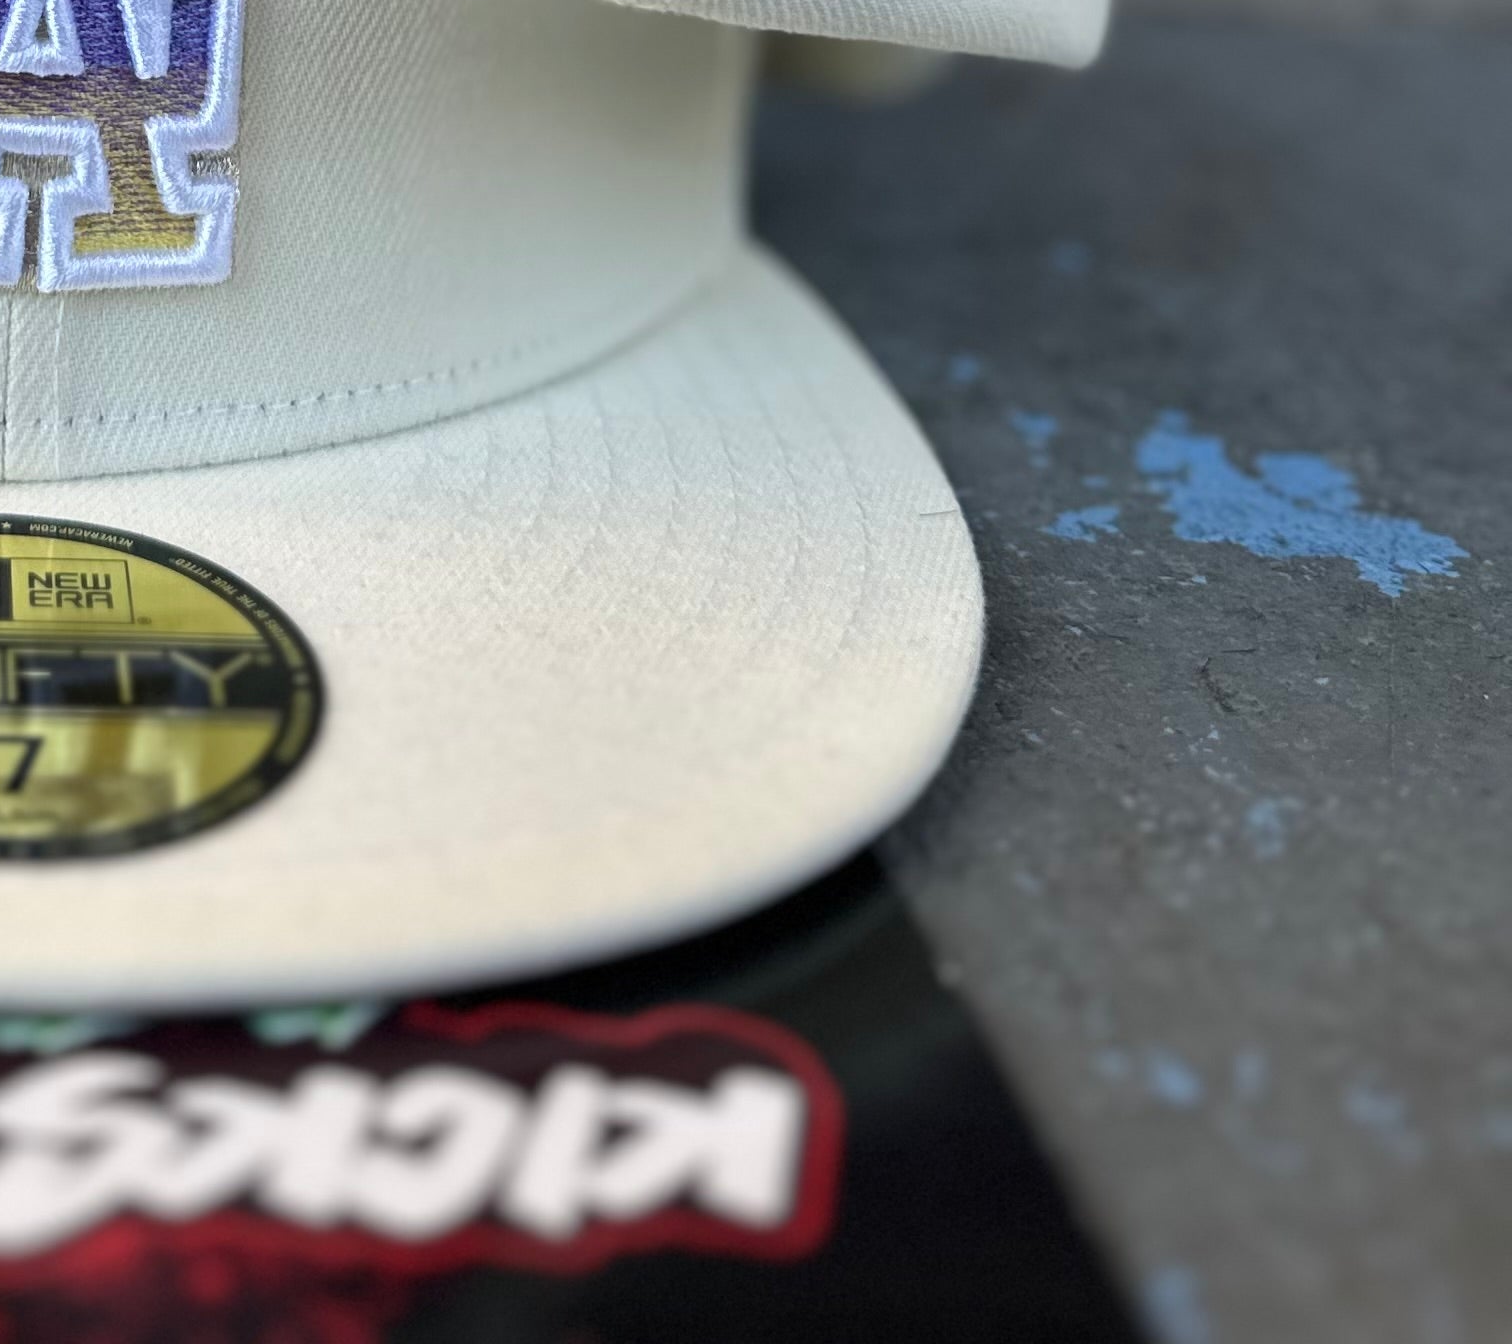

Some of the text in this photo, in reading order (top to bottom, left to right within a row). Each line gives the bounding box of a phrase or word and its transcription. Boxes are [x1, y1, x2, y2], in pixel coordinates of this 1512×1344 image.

[29, 522, 134, 548] NEWERACAP.COM
[28, 571, 112, 590] NEW
[210, 575, 239, 595] TRUE
[28, 590, 114, 609] ERA
